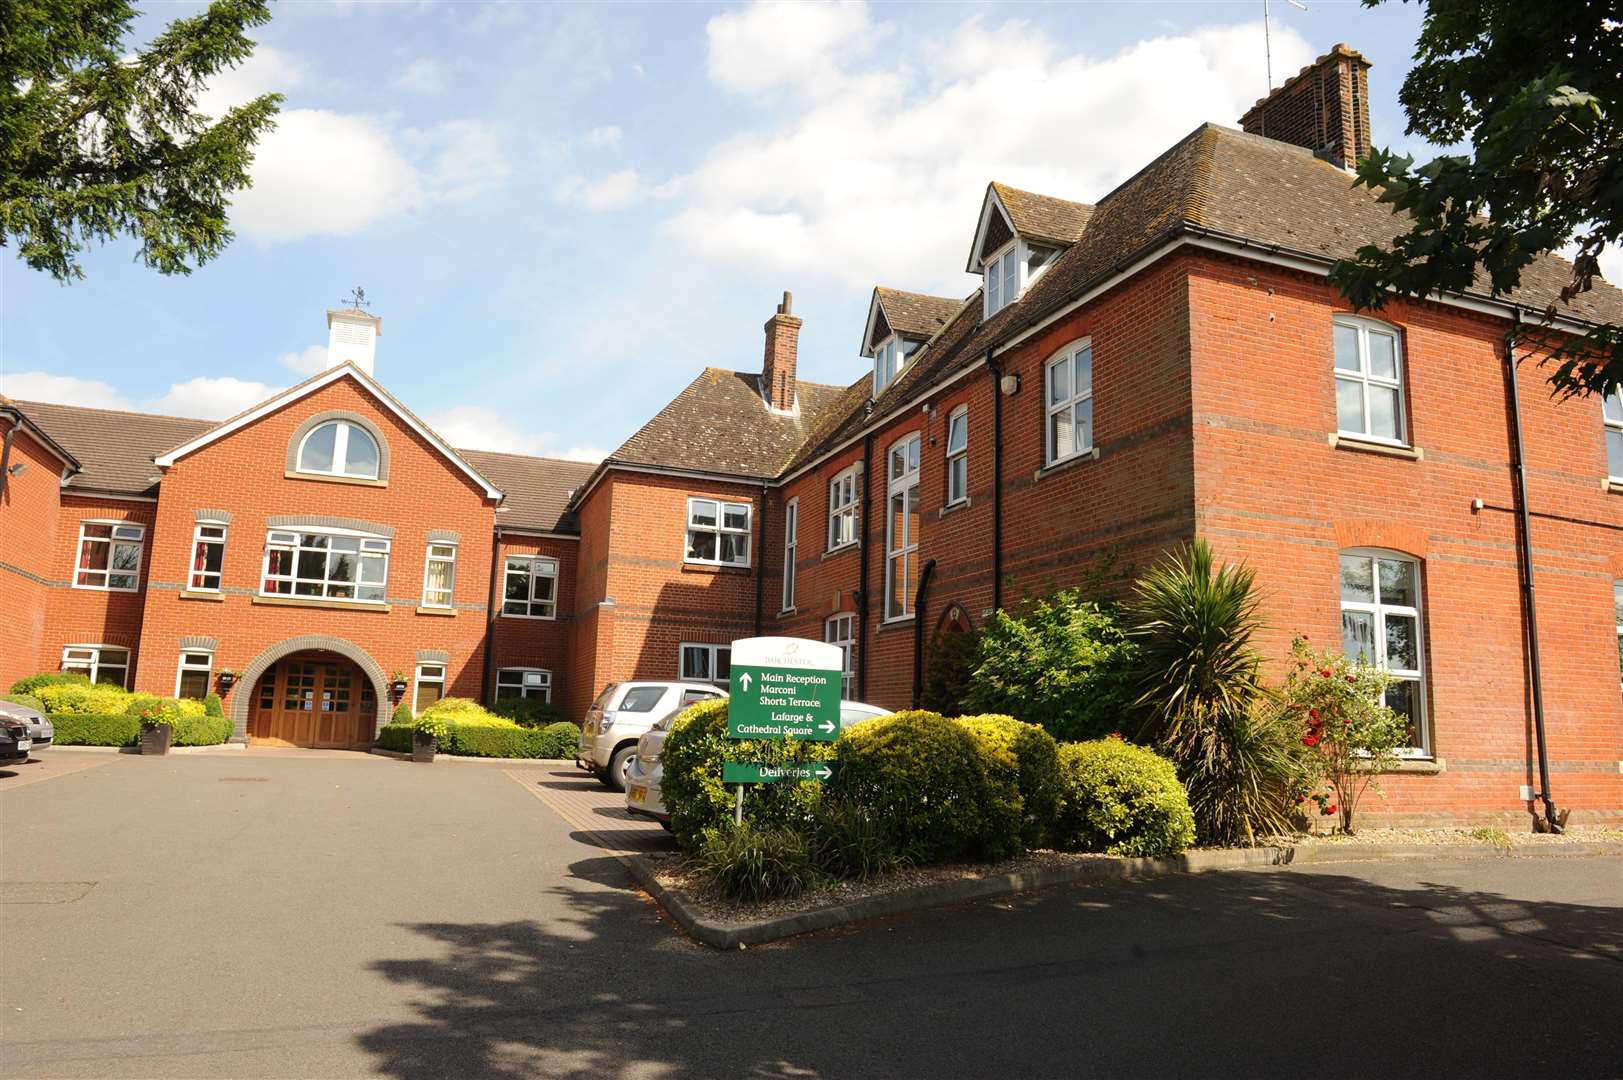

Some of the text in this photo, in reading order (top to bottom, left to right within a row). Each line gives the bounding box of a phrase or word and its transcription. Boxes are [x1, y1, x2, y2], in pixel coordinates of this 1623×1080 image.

[761, 673, 827, 686] Main Reception
[760, 684, 796, 695] Marconi
[759, 696, 820, 707] Shorts Terrace
[771, 712, 814, 723] Lafarge &
[737, 724, 813, 736] Cathedral Square
